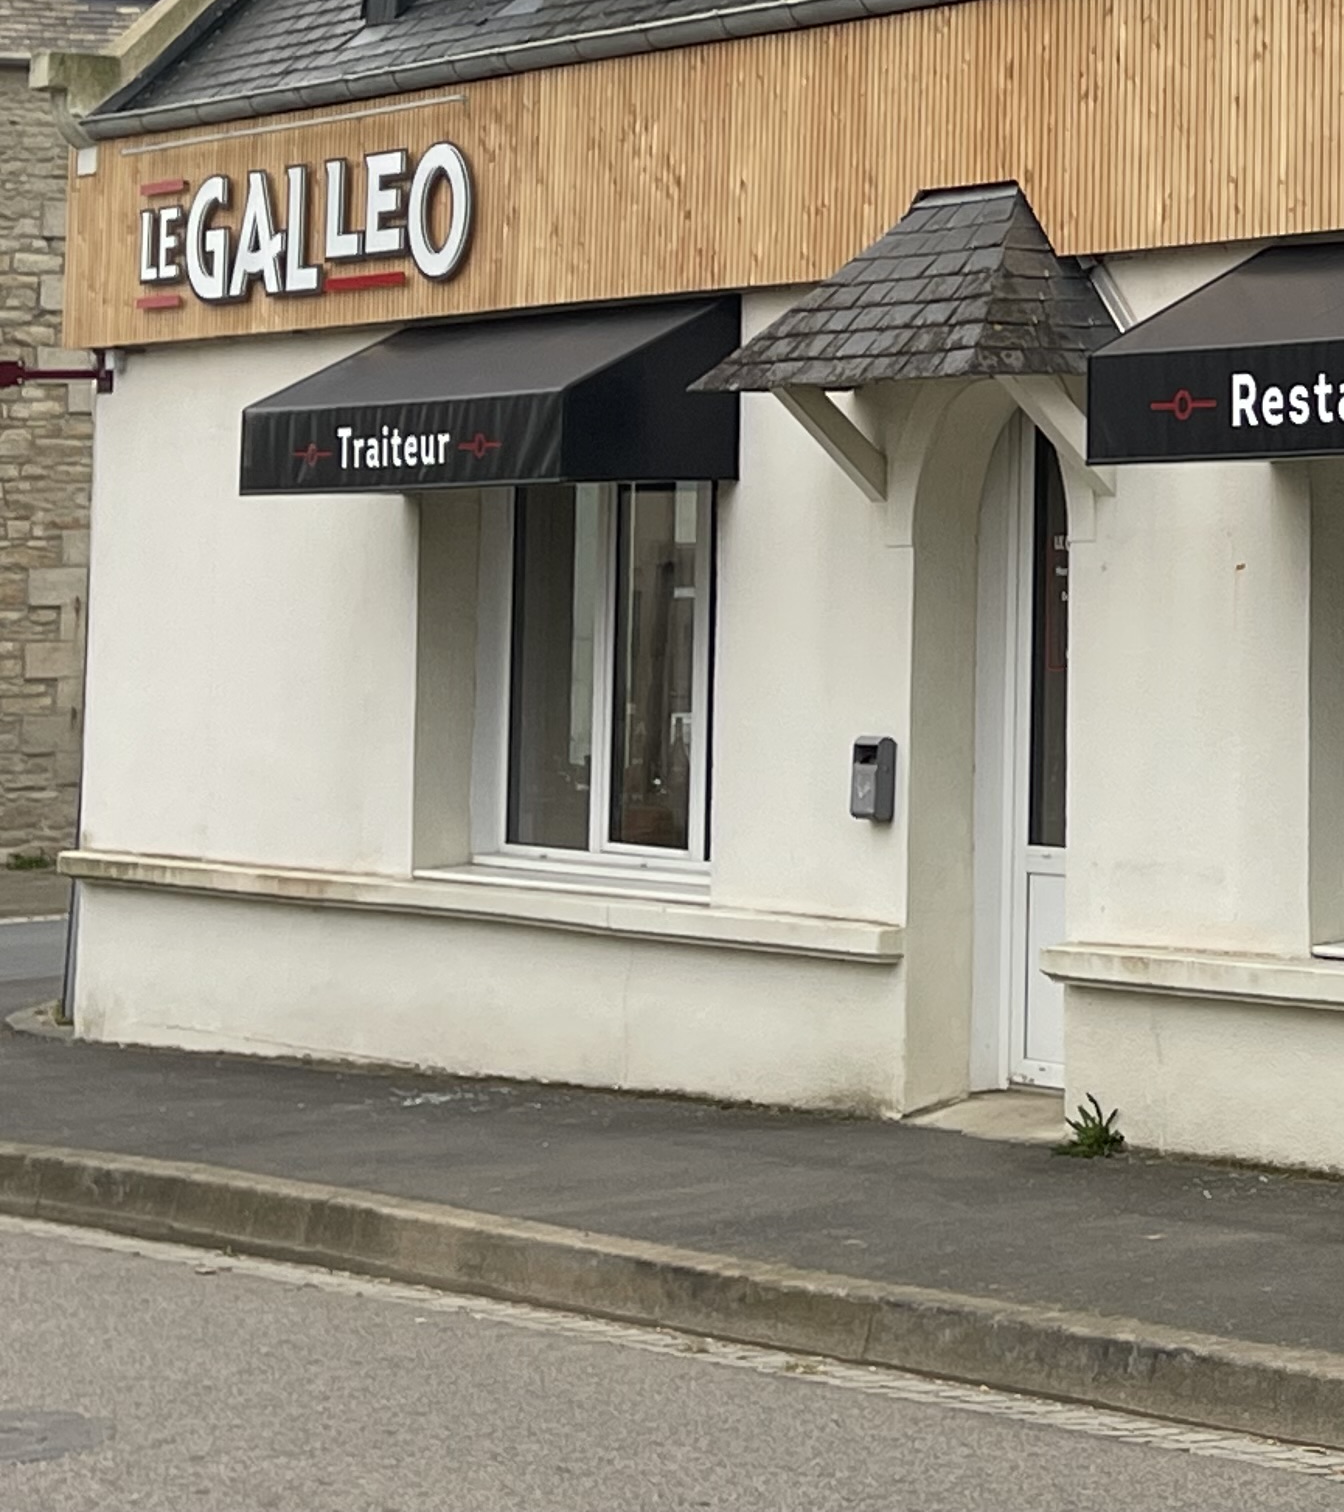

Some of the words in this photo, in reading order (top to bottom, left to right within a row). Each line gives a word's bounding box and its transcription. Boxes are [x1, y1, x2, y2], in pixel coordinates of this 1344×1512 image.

[140, 204, 184, 283] LE
[185, 141, 475, 304] GALLEO
[337, 425, 450, 469] Traiteur
